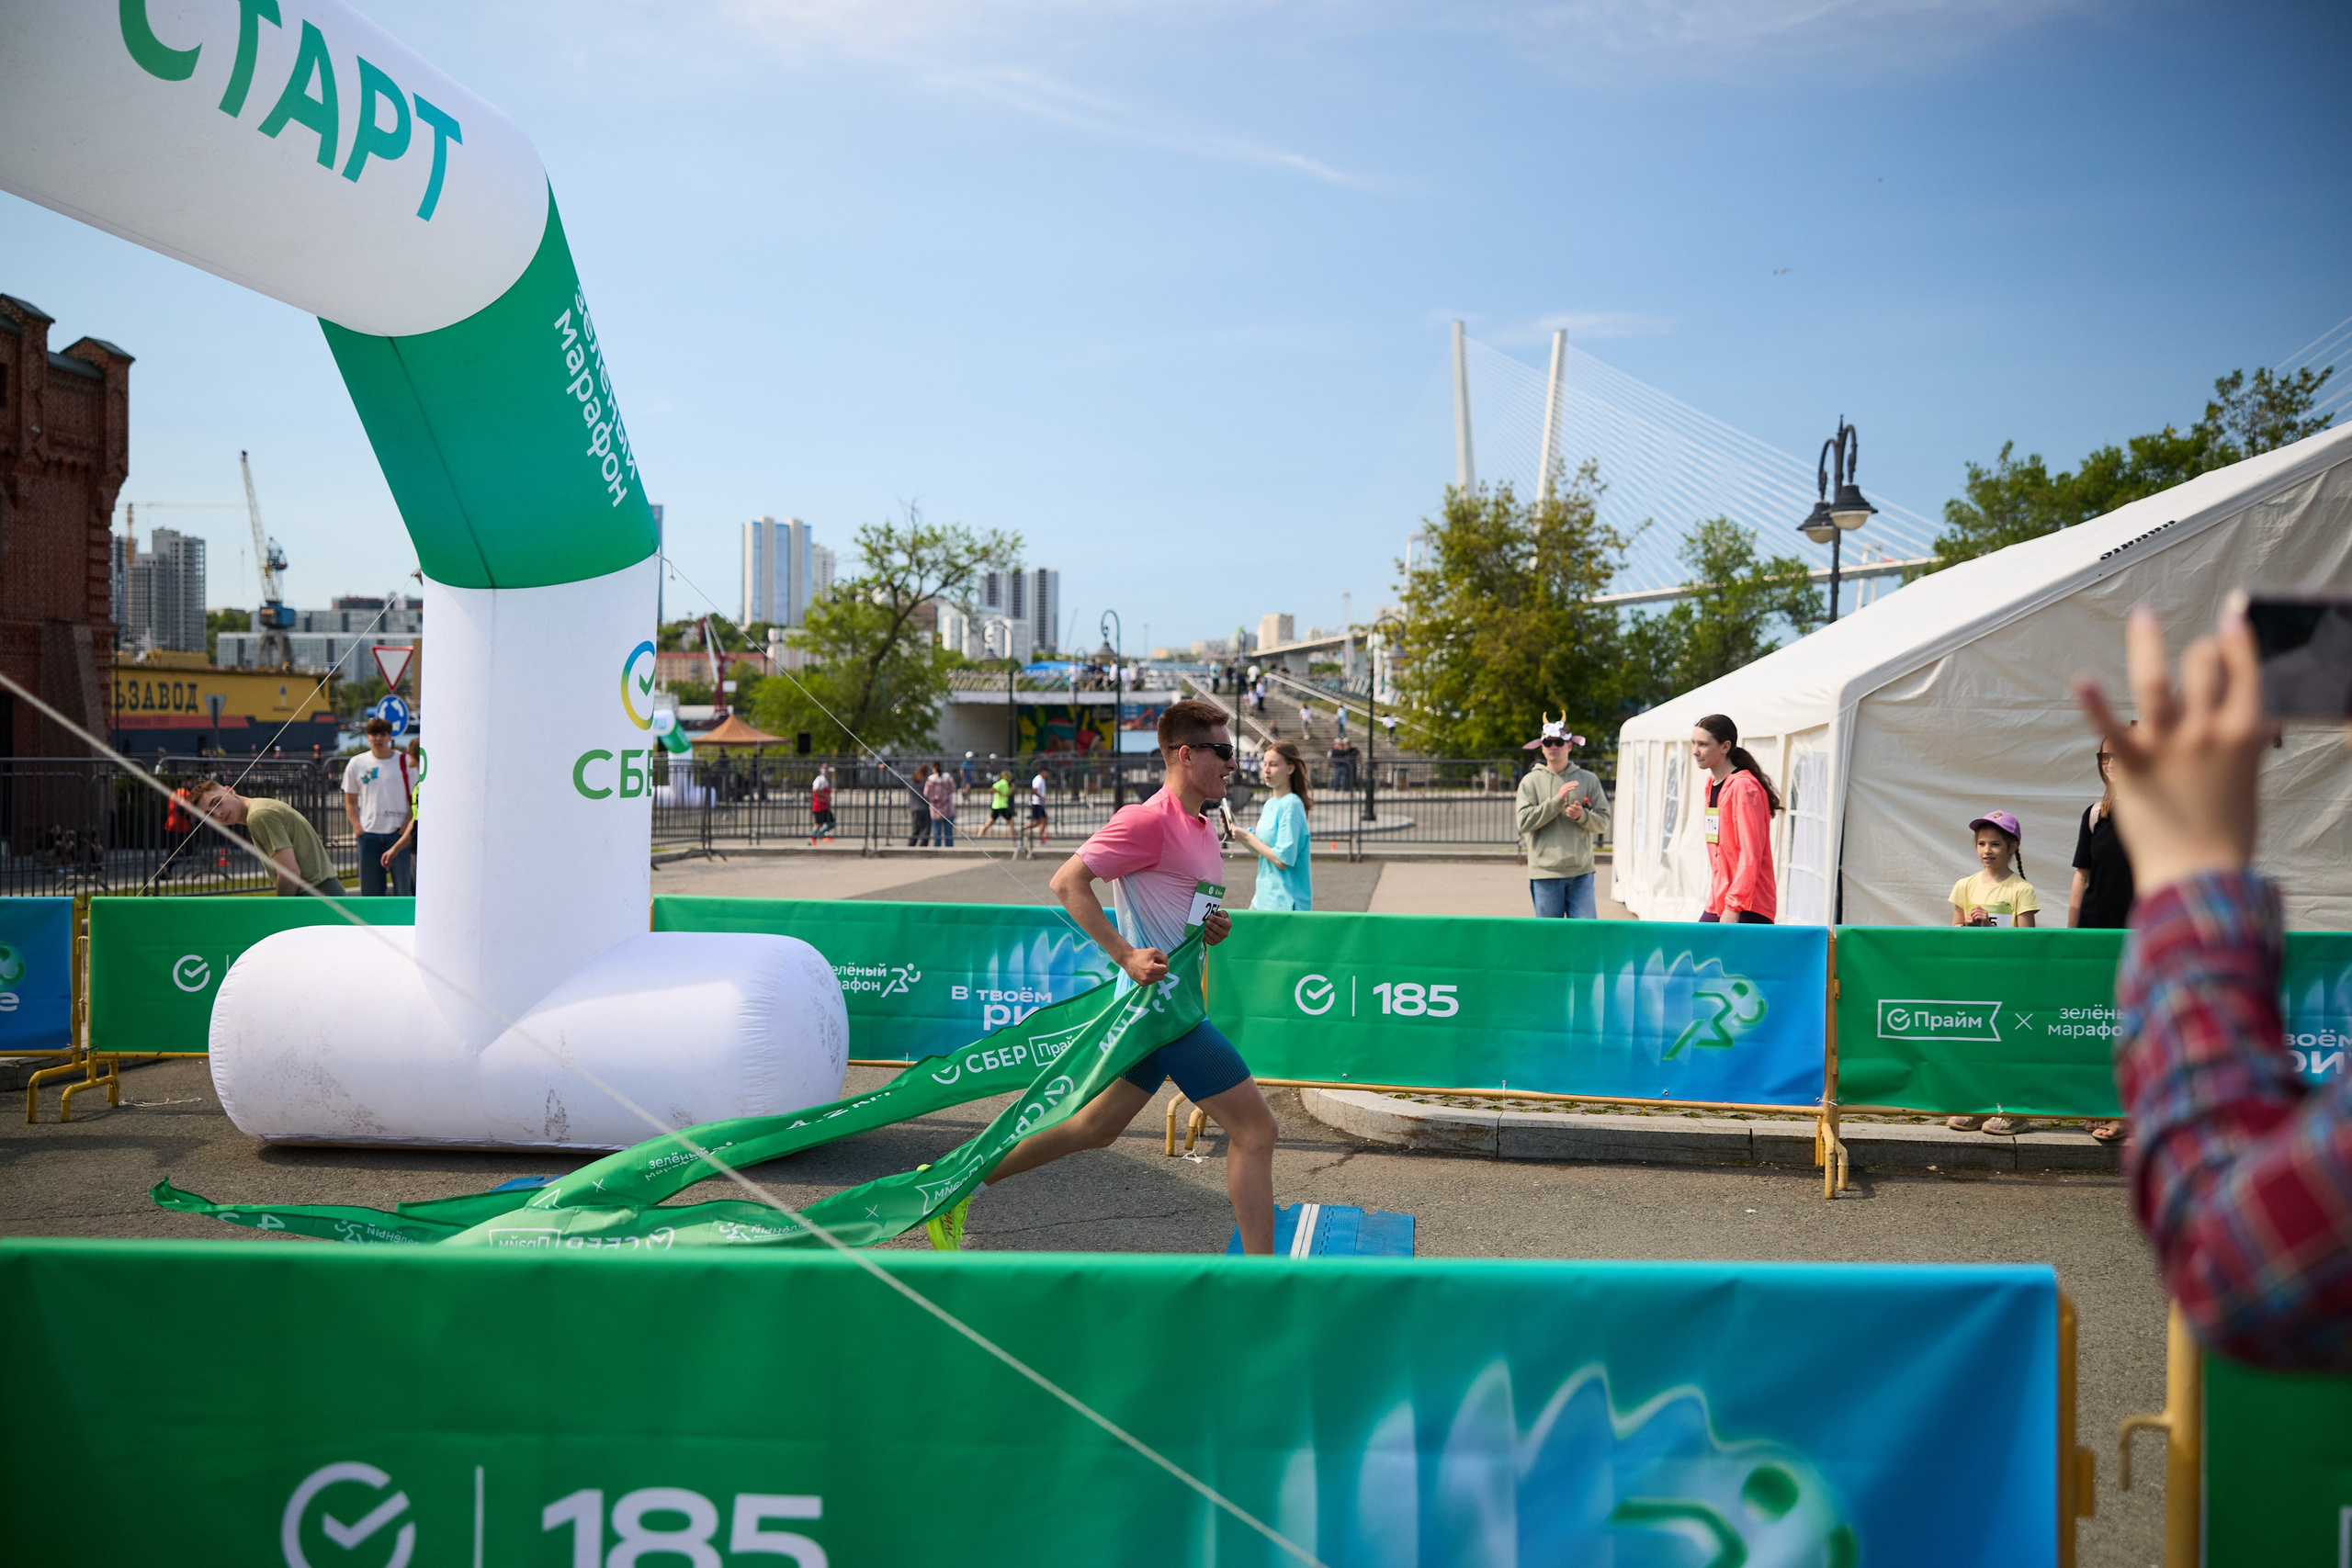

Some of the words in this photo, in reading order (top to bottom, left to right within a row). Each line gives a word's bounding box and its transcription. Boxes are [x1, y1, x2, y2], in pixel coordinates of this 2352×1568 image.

[119, 0, 463, 222] СТАРТ
[554, 308, 628, 508] марафон
[831, 962, 888, 977] елёный
[951, 986, 969, 1000] В
[976, 987, 1052, 1004] твоём
[1373, 982, 1460, 1018] 185
[1914, 1011, 1983, 1032] Прайм
[2047, 1021, 2124, 1041] марафо
[965, 1045, 1027, 1074] СБЕР
[542, 1486, 830, 1568] 185
